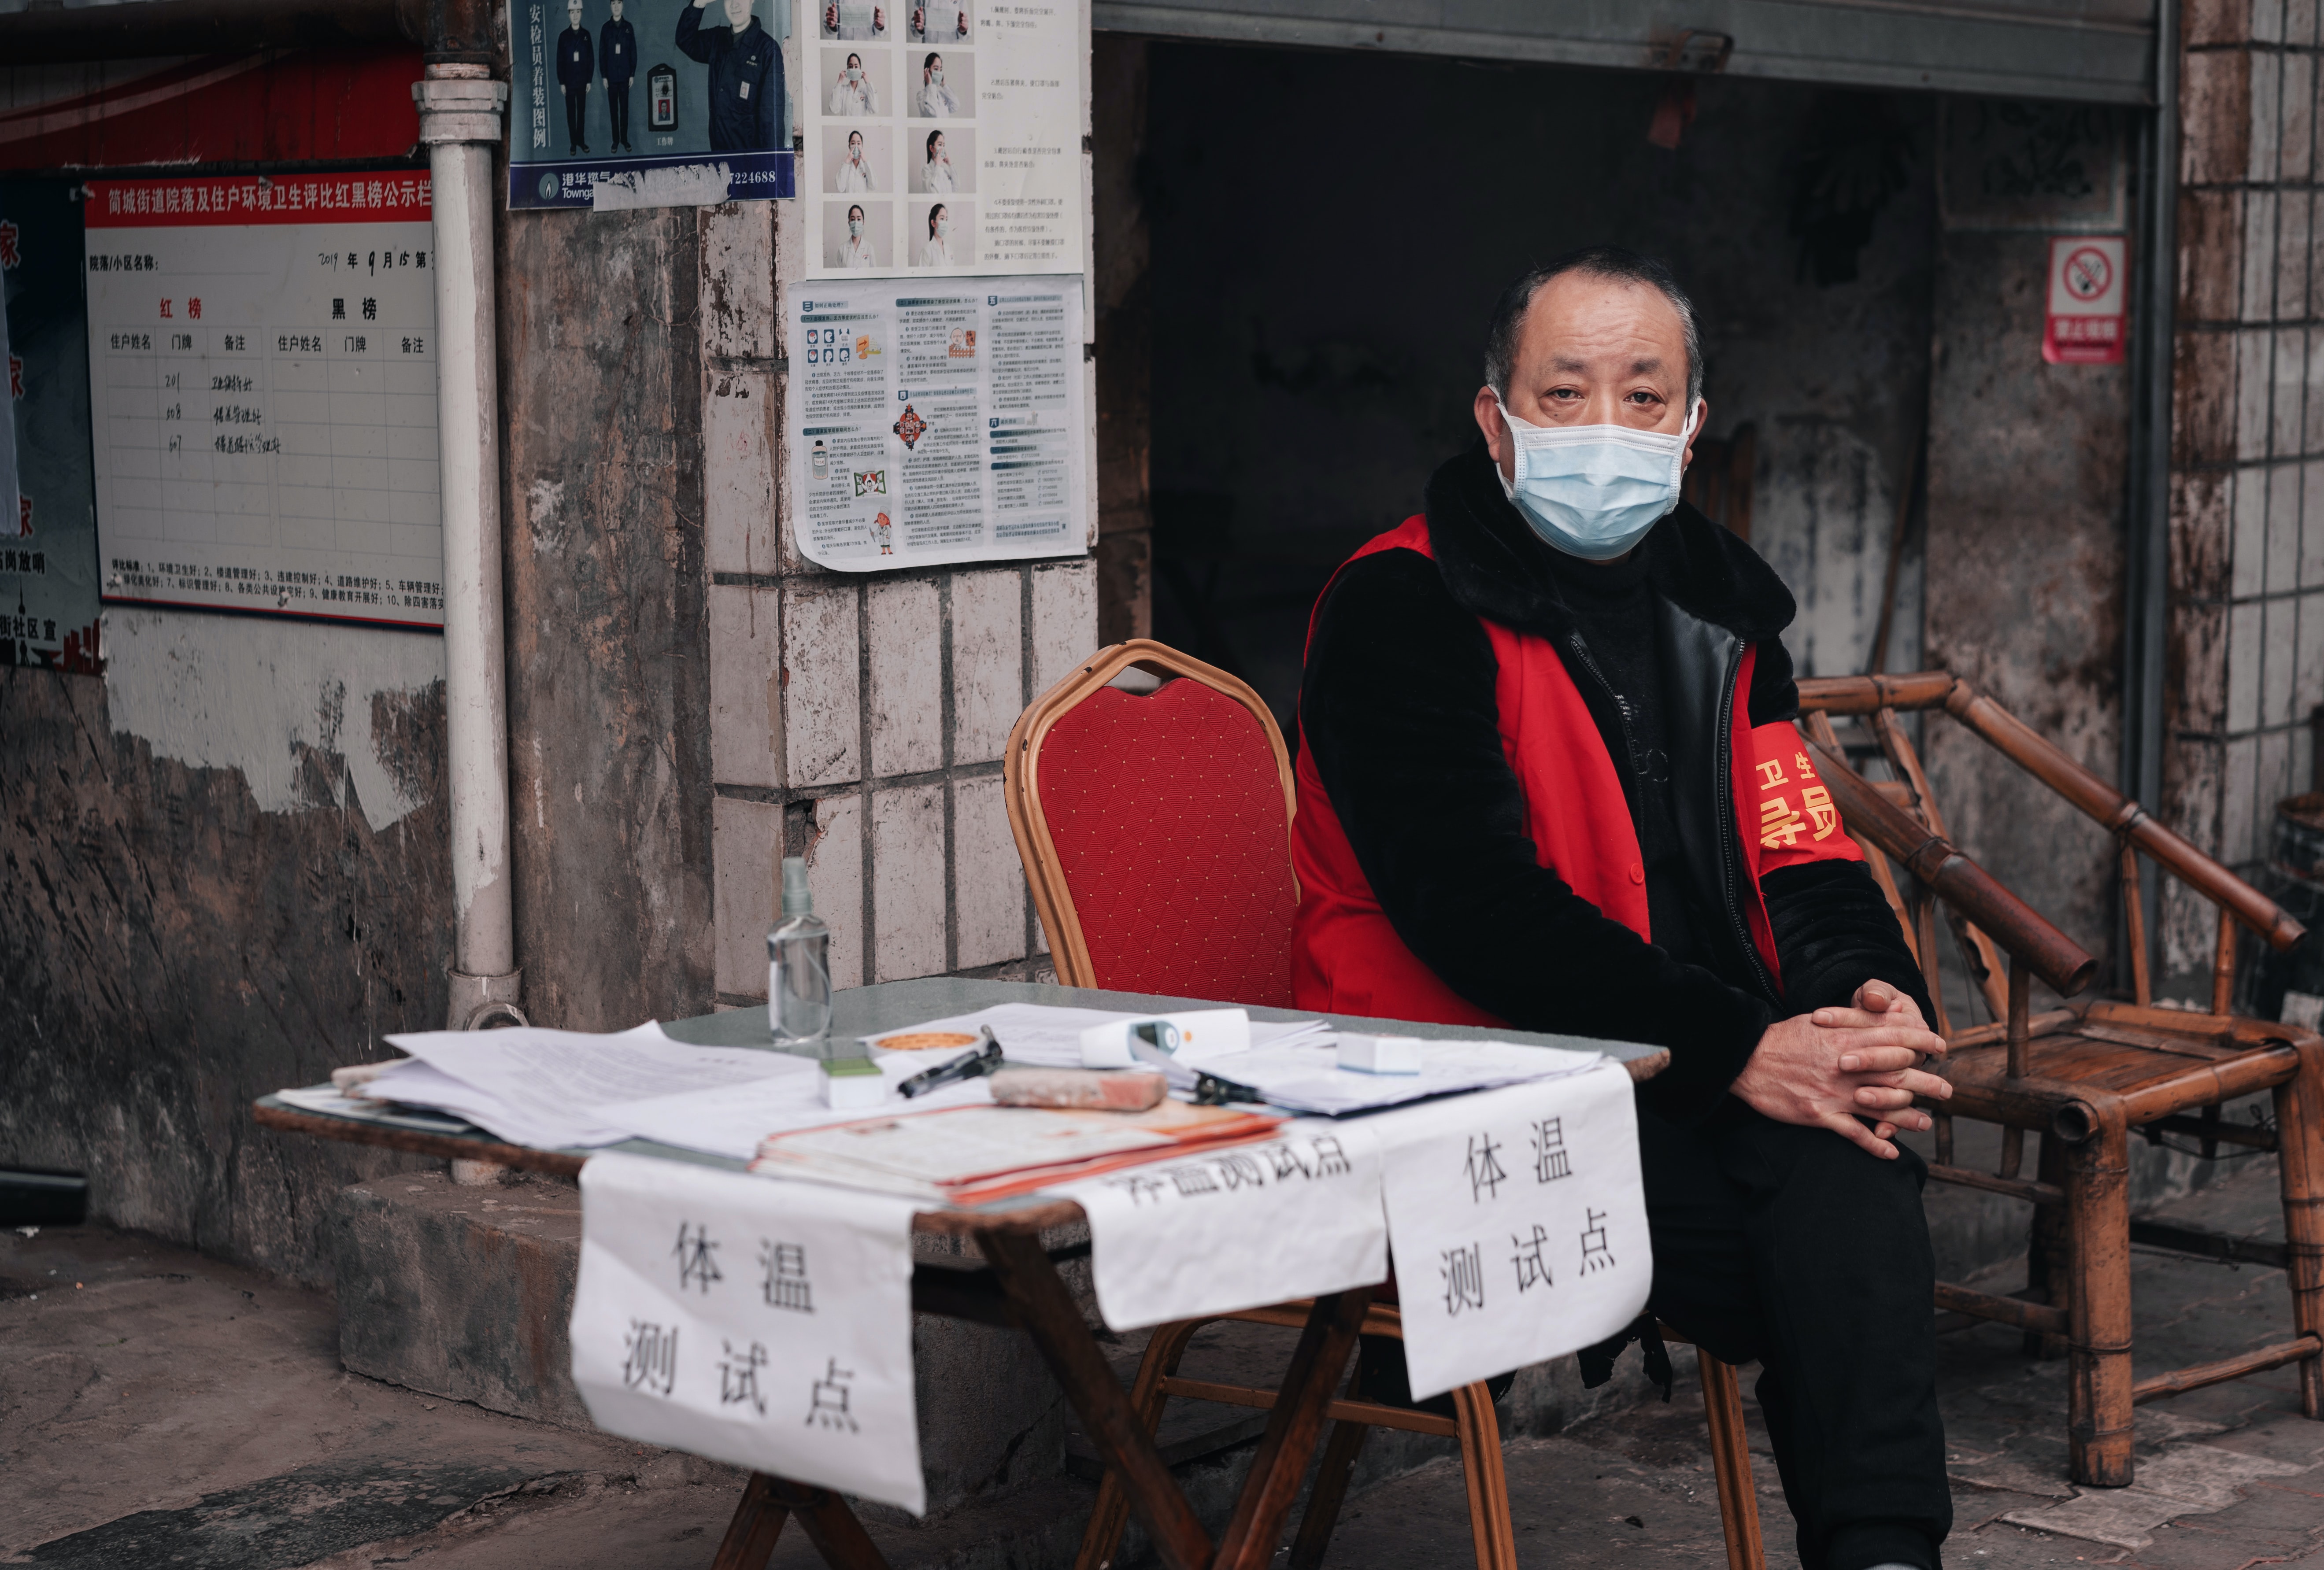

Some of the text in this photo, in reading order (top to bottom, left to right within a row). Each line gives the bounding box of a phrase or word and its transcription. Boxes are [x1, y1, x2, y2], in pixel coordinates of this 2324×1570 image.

[529, 4, 546, 148] 安检员着装图例
[657, 137, 674, 146] 工作牌
[562, 171, 610, 187] 港华燃气
[108, 180, 432, 215] 简城街道院落及住户环境卫生评比红黑榜公示栏
[347, 251, 358, 269] 年
[369, 251, 375, 276] 9
[383, 251, 393, 269] 月
[416, 251, 427, 270] 第
[160, 298, 377, 321] 红榜 黑榜
[110, 333, 424, 354] 住户姓名 门牌 备注 住户姓名 门牌 备注
[0, 549, 44, 575] 岗放哨
[1756, 752, 1815, 790] 卫生
[1463, 1116, 1573, 1203] 体温
[670, 1219, 816, 1315] 体温
[1440, 1207, 1616, 1317] 测试点
[622, 1315, 860, 1434] 测试点
